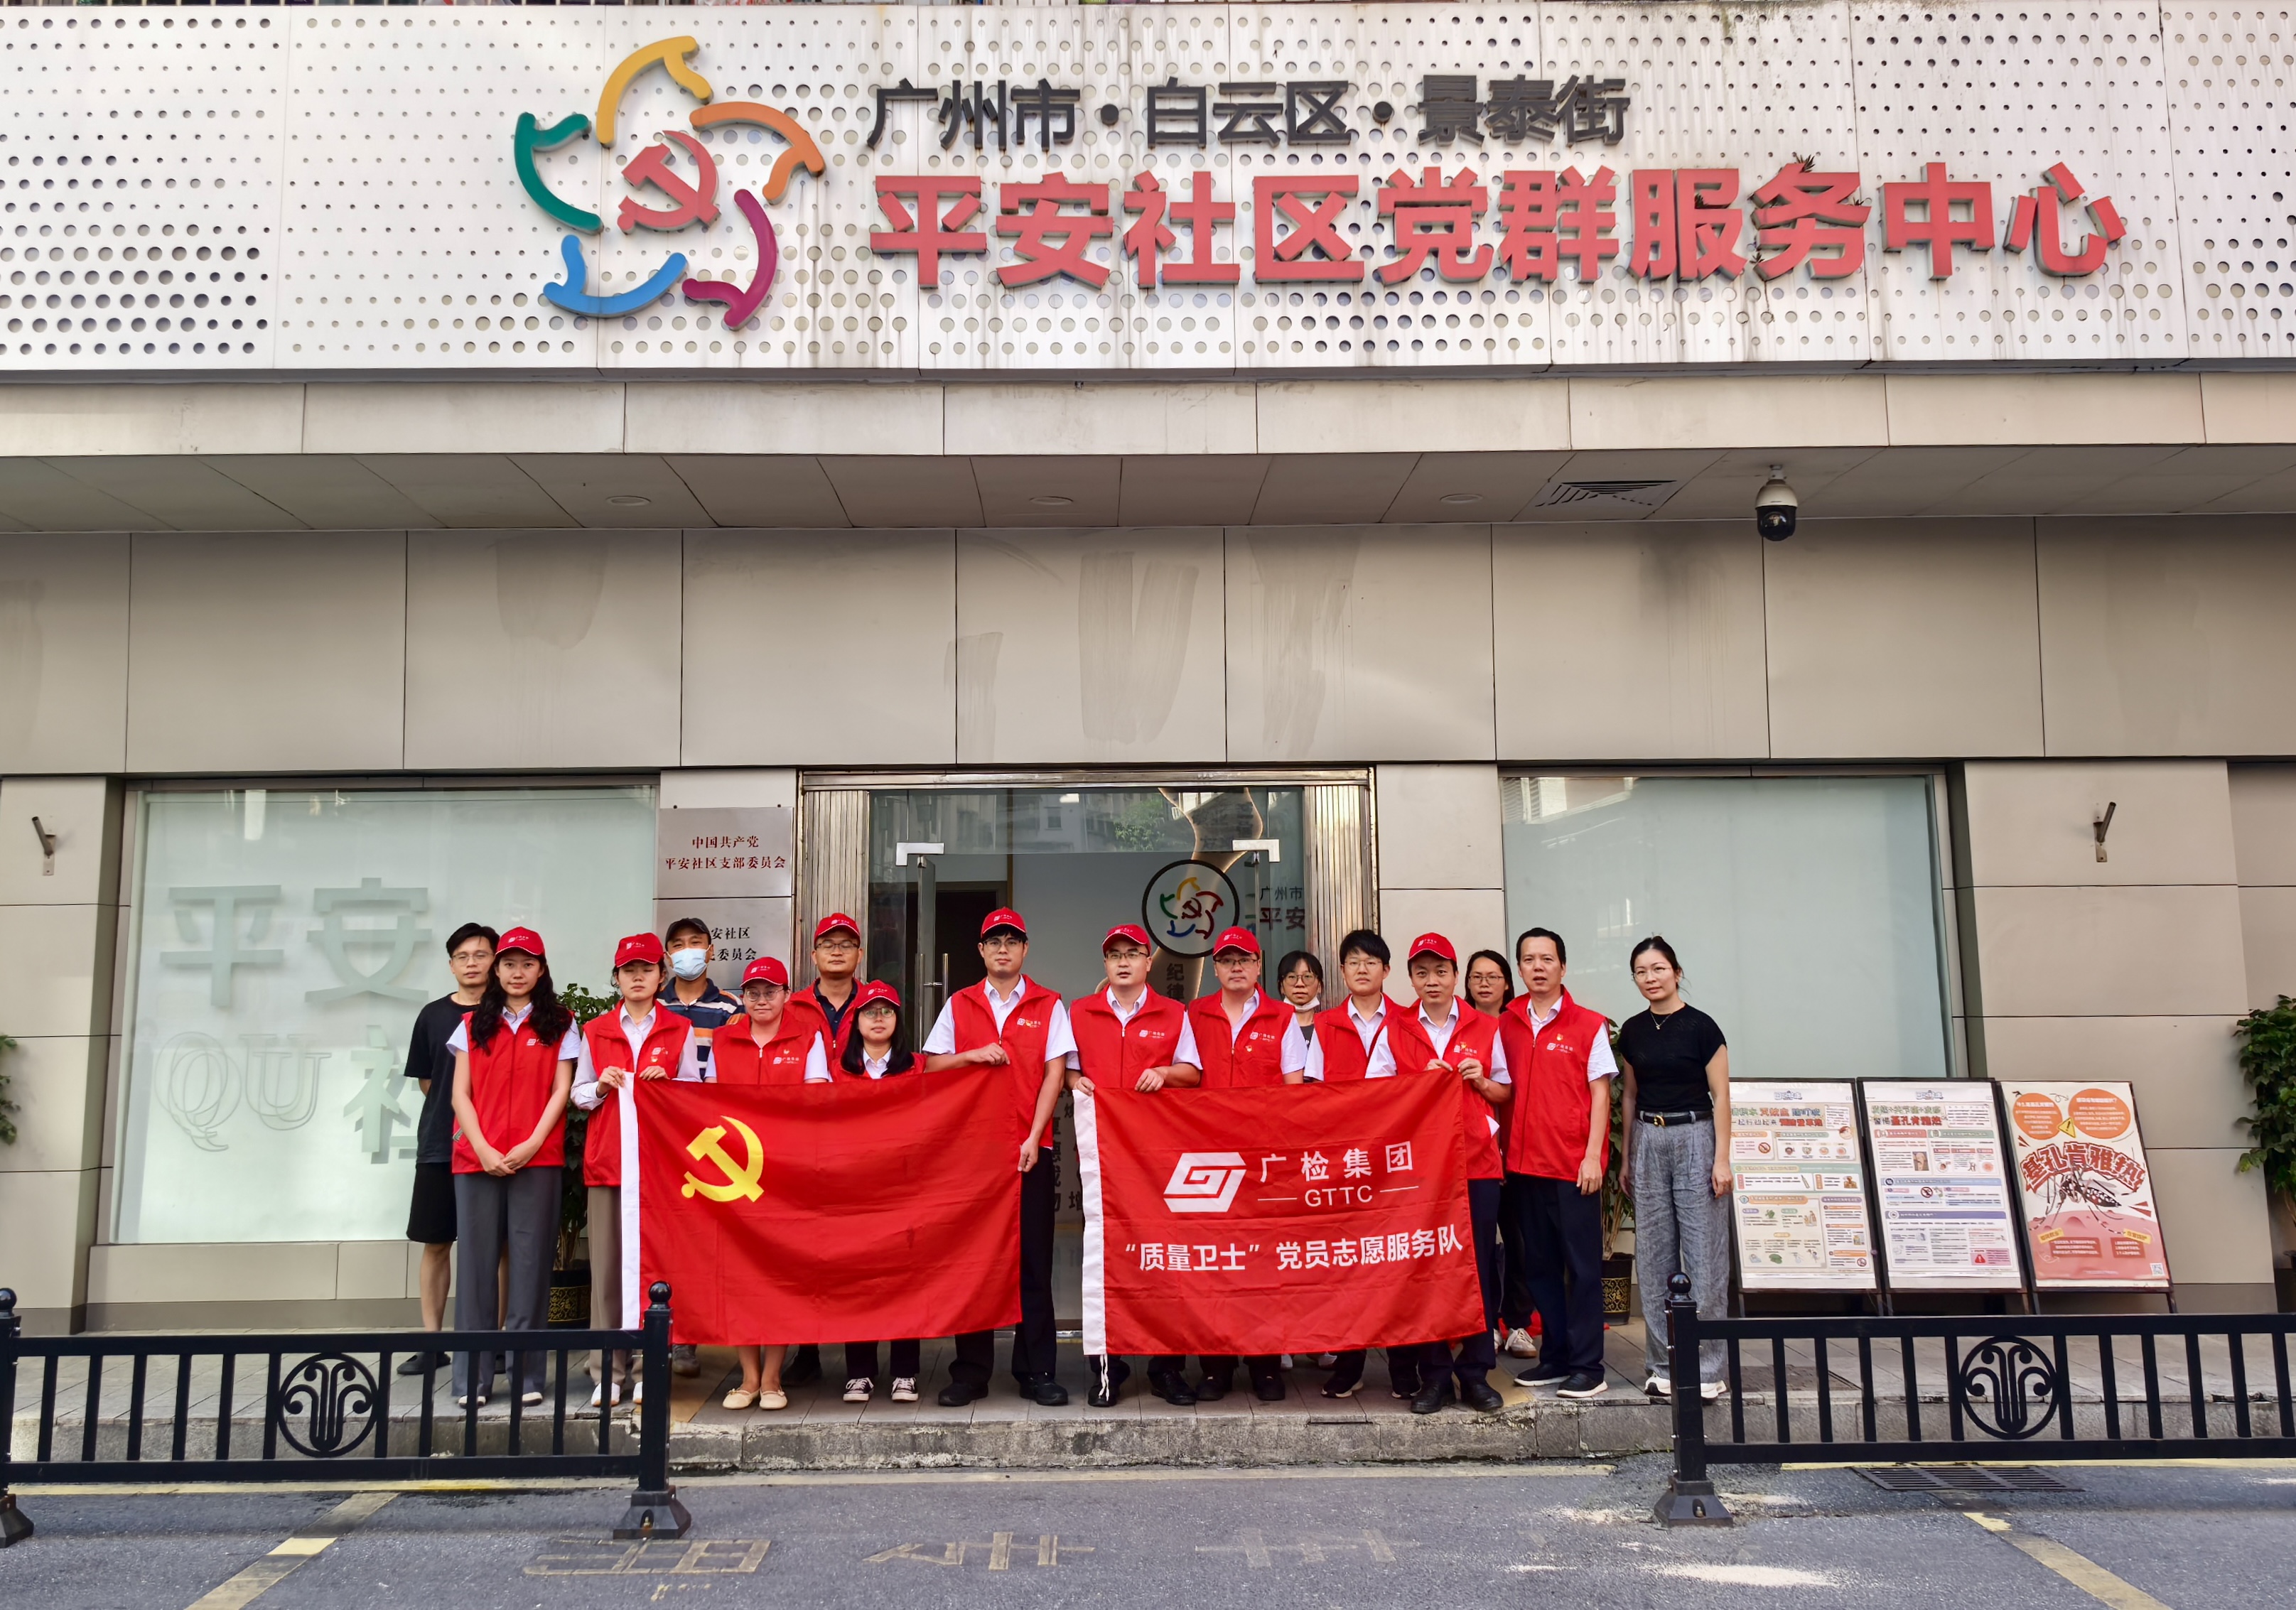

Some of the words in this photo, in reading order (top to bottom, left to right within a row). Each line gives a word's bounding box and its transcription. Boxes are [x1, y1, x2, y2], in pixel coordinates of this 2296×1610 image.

[870, 161, 2127, 288] 平安社区党群服务中心
[665, 855, 786, 870] 平安社区支部委员会
[691, 835, 759, 849] 中国共产党
[160, 877, 433, 1007] 平安
[1260, 1141, 1413, 1183] 广检集团
[2020, 1142, 2145, 1192] 基孔肯雅热
[1305, 1185, 1373, 1207] GTTC
[1276, 1223, 1463, 1270] 党员志愿服务队
